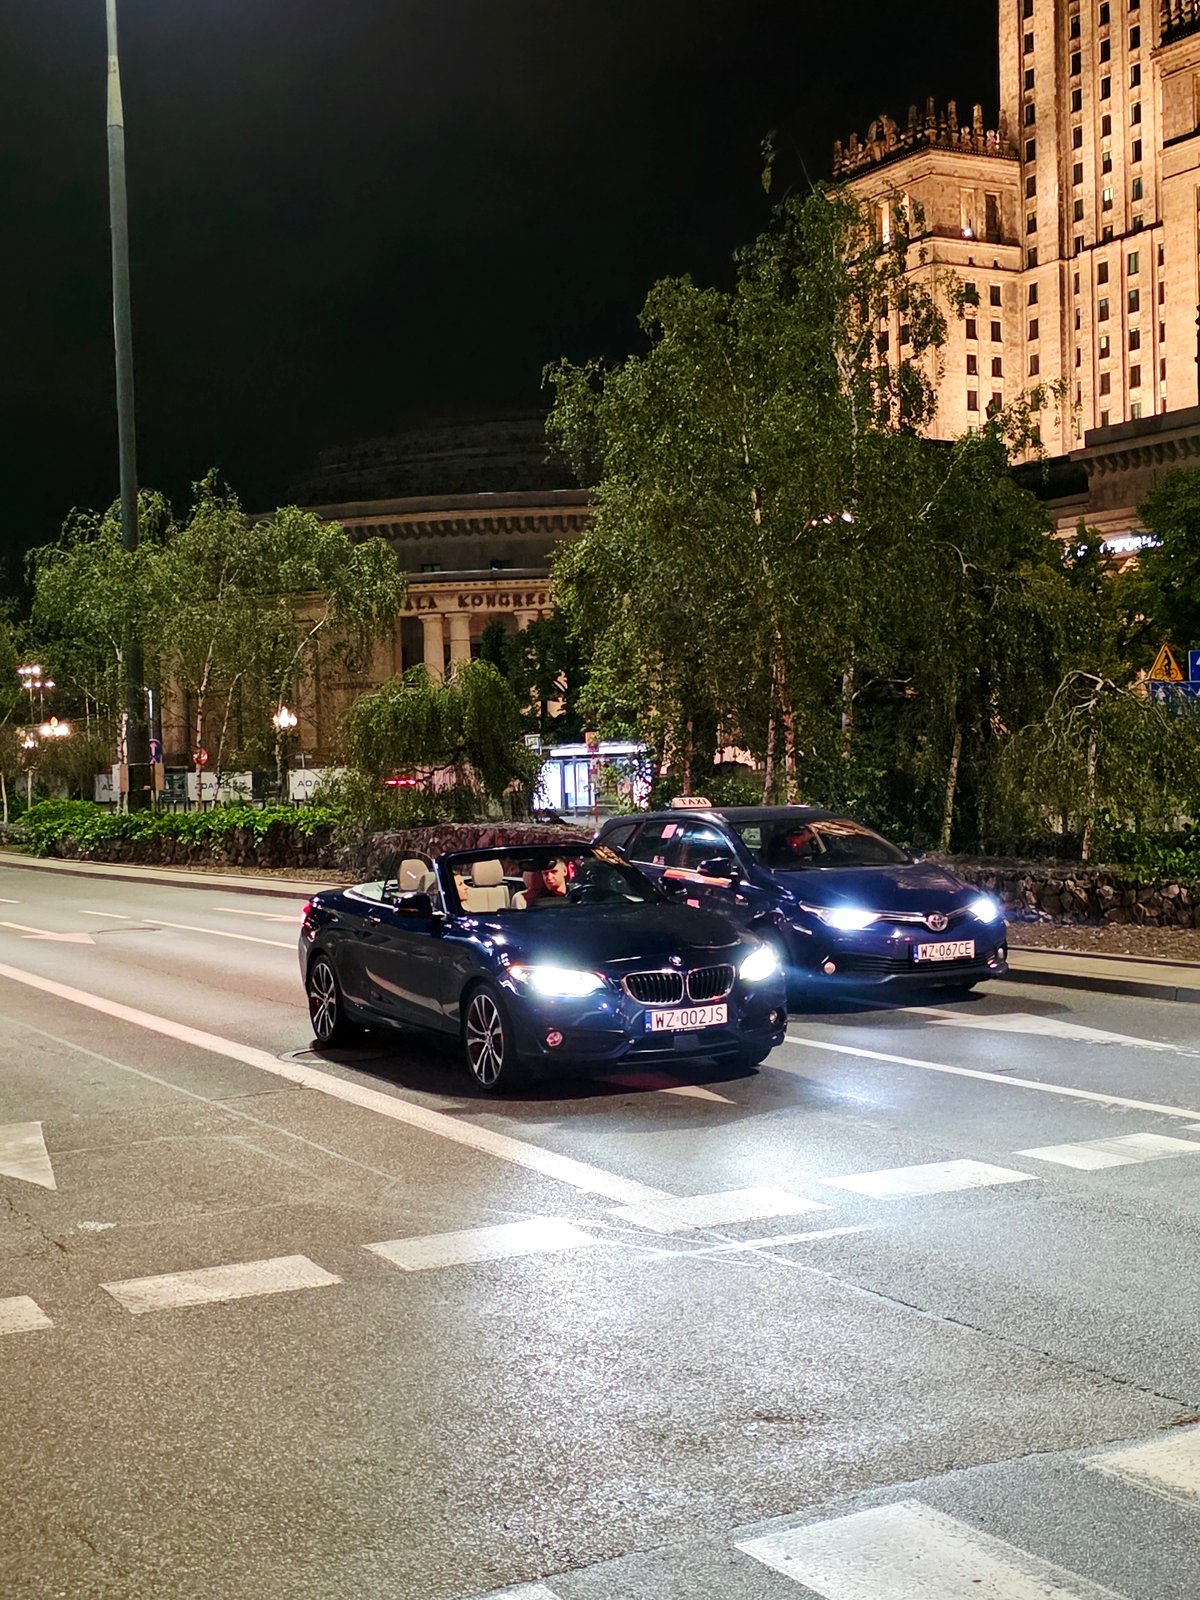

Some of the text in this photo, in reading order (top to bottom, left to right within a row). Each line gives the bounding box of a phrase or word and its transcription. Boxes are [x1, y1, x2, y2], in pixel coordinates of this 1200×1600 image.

[402, 595, 437, 610] ALA
[920, 942, 972, 958] WZ 067CE
[655, 1006, 724, 1028] WZ 002JS
